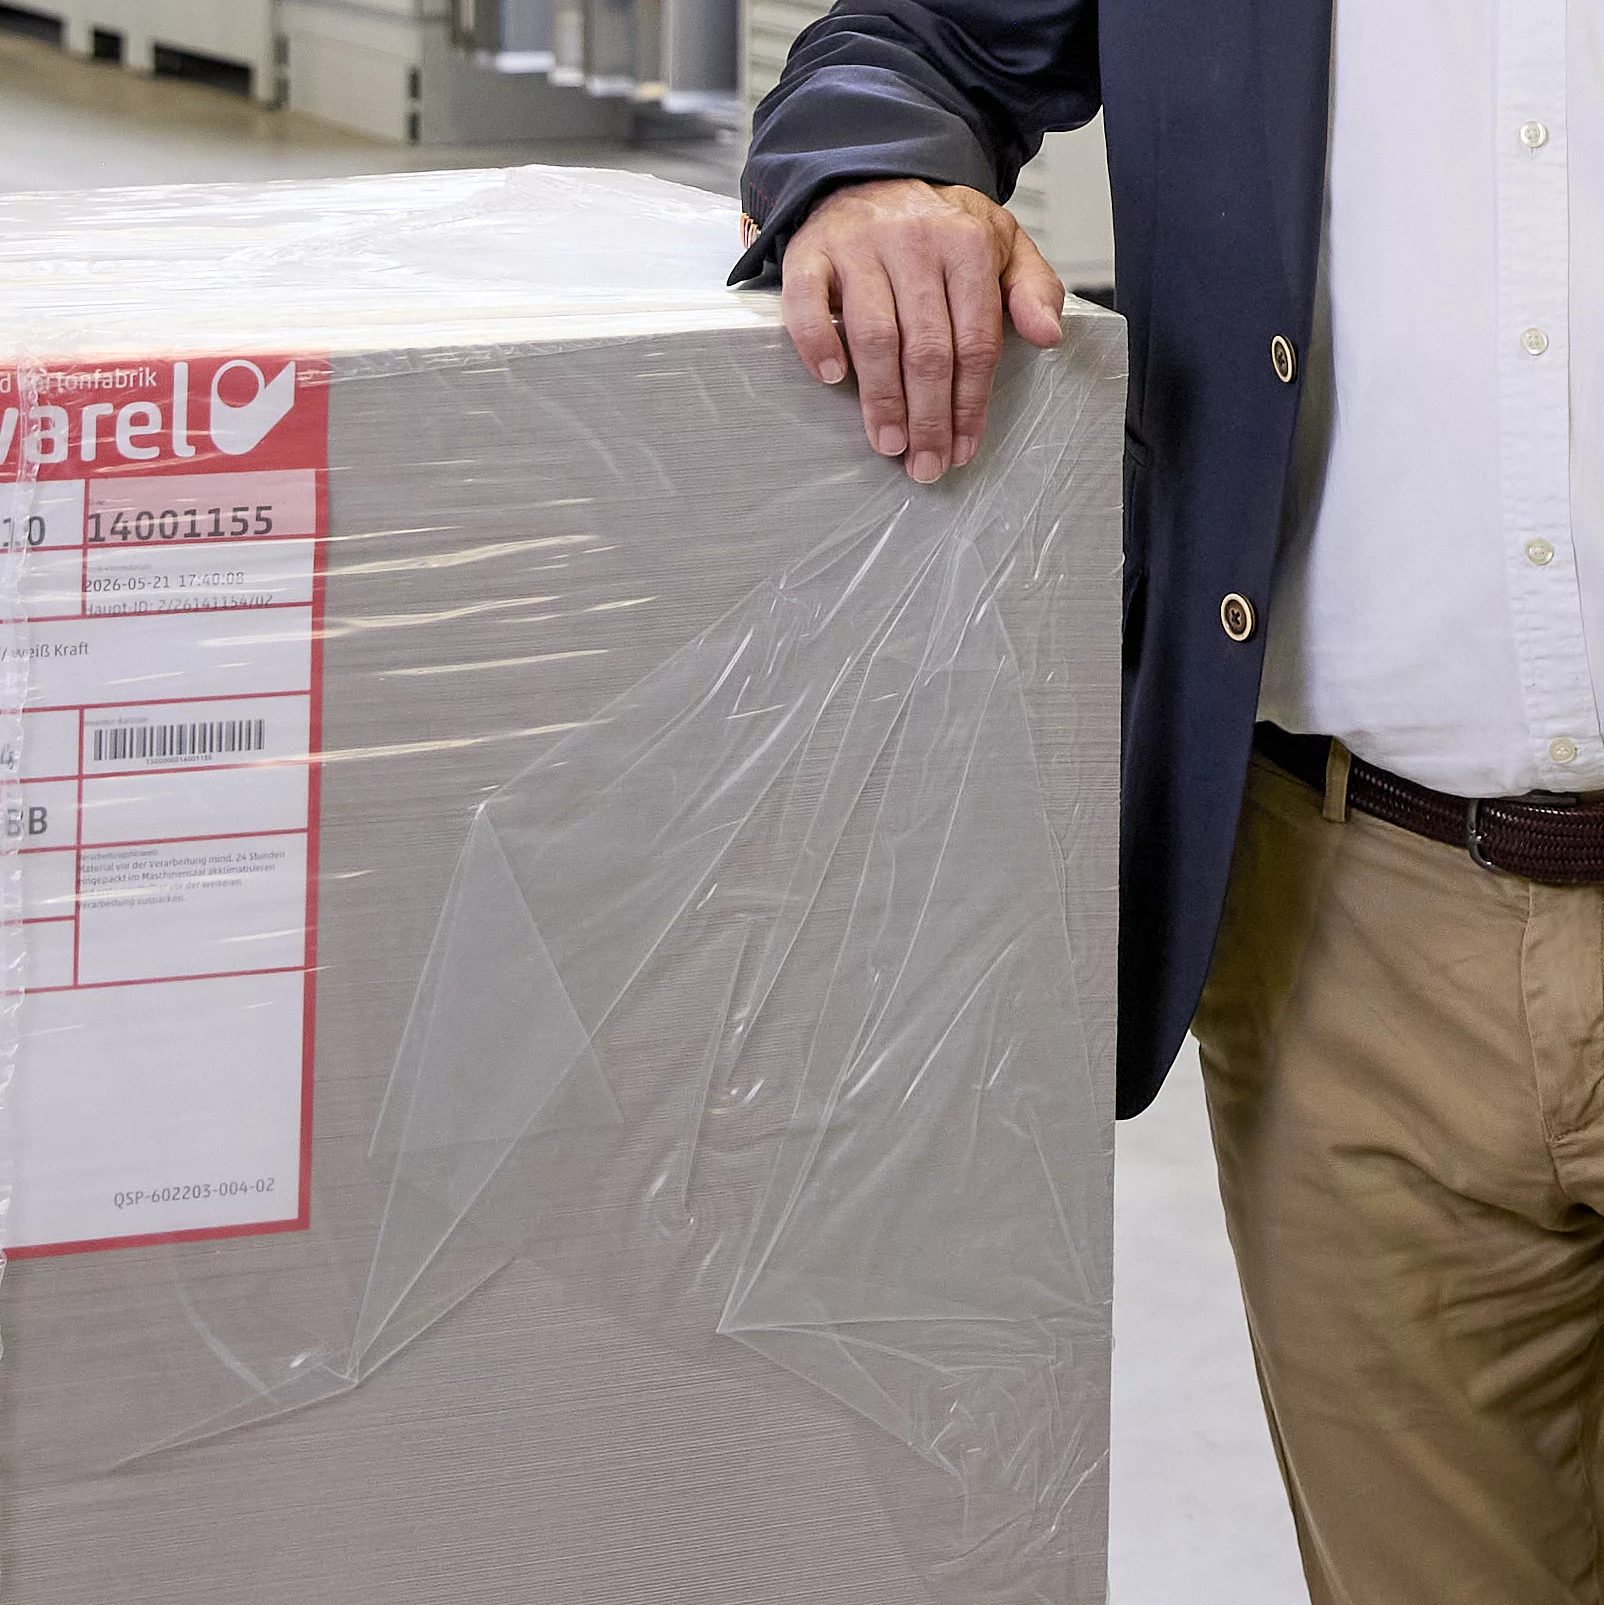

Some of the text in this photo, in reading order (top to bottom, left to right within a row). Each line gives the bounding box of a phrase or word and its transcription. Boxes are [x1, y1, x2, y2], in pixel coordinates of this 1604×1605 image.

[20, 366, 157, 395] artonfabrik
[88, 505, 274, 543] 14001155
[85, 576, 170, 593] 2026-05-21
[54, 642, 88, 656] Kraft
[235, 853, 248, 862] 24
[249, 851, 285, 861] Stunden
[113, 1177, 276, 1209] QSP-602203-004-02
